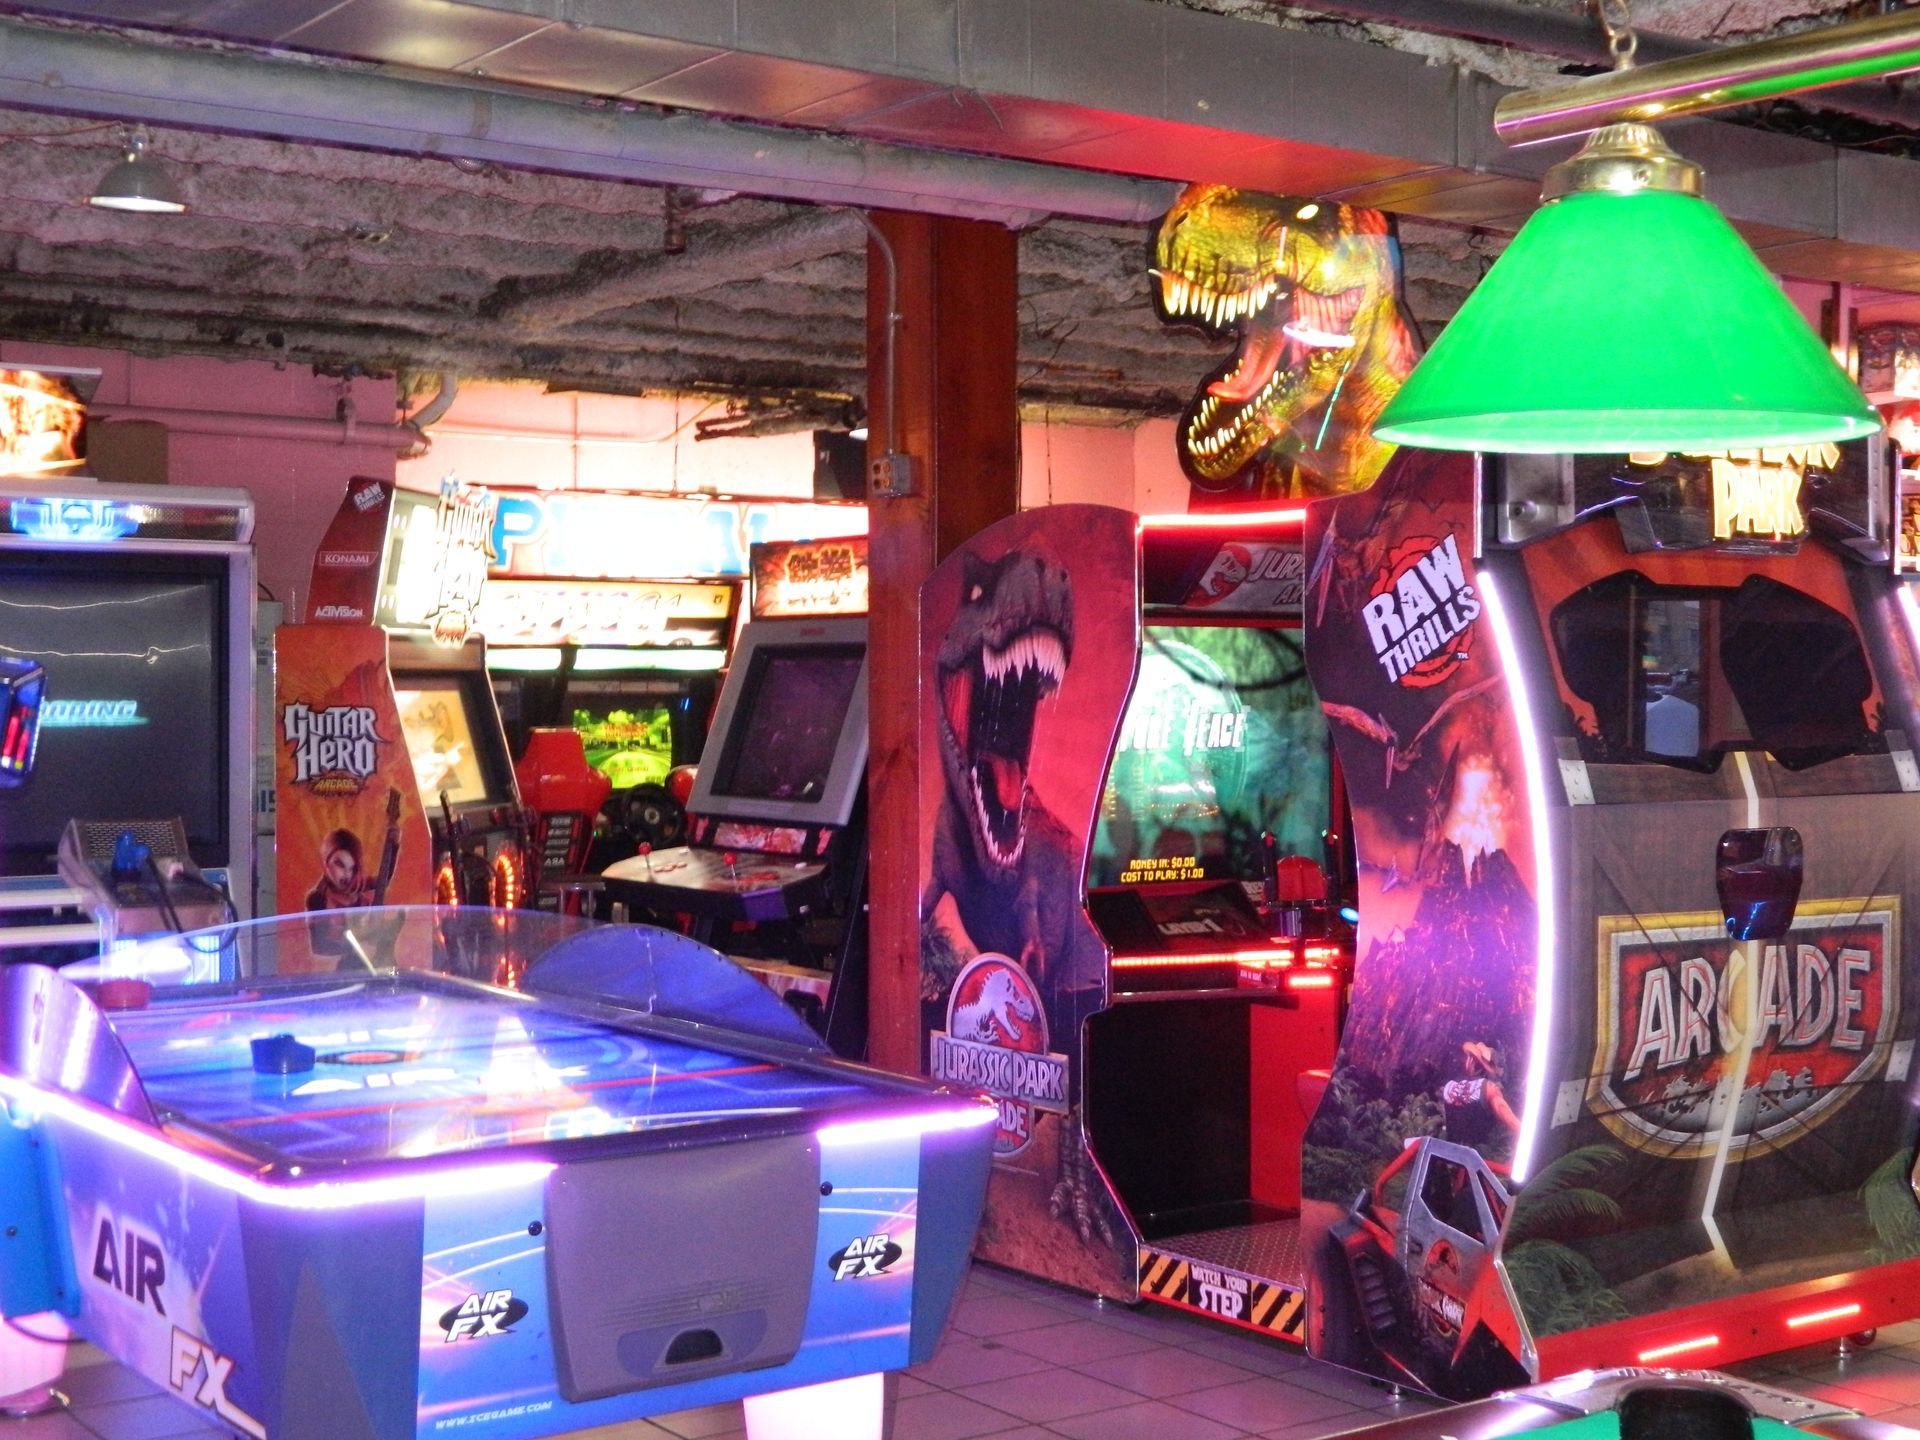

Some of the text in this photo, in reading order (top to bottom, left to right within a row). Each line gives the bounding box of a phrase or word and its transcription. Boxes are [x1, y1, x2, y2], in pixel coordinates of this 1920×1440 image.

[1711, 459, 1804, 538] PARK
[325, 554, 369, 563] KONAMI
[1362, 533, 1465, 654] RAW
[315, 605, 363, 618] ACTIVISION
[1379, 586, 1480, 683] THRILLS
[1121, 872, 1141, 882] COST
[1144, 871, 1154, 881] TO
[1155, 869, 1179, 880] PLAY:
[1130, 856, 1195, 869] MONEY IN: $0.00
[1623, 944, 1871, 1082] ARCADE
[933, 1037, 1064, 1102] JURASSIC PARK
[996, 1100, 1028, 1138] ADE
[842, 1234, 889, 1257] AIR
[93, 1217, 167, 1318] AIR
[833, 1254, 886, 1281] FX
[1190, 1263, 1248, 1295] WATCH YOUR
[457, 1289, 512, 1316] AIR
[1199, 1282, 1243, 1319] STEP
[445, 1311, 509, 1343] FX
[170, 1325, 267, 1440] FX
